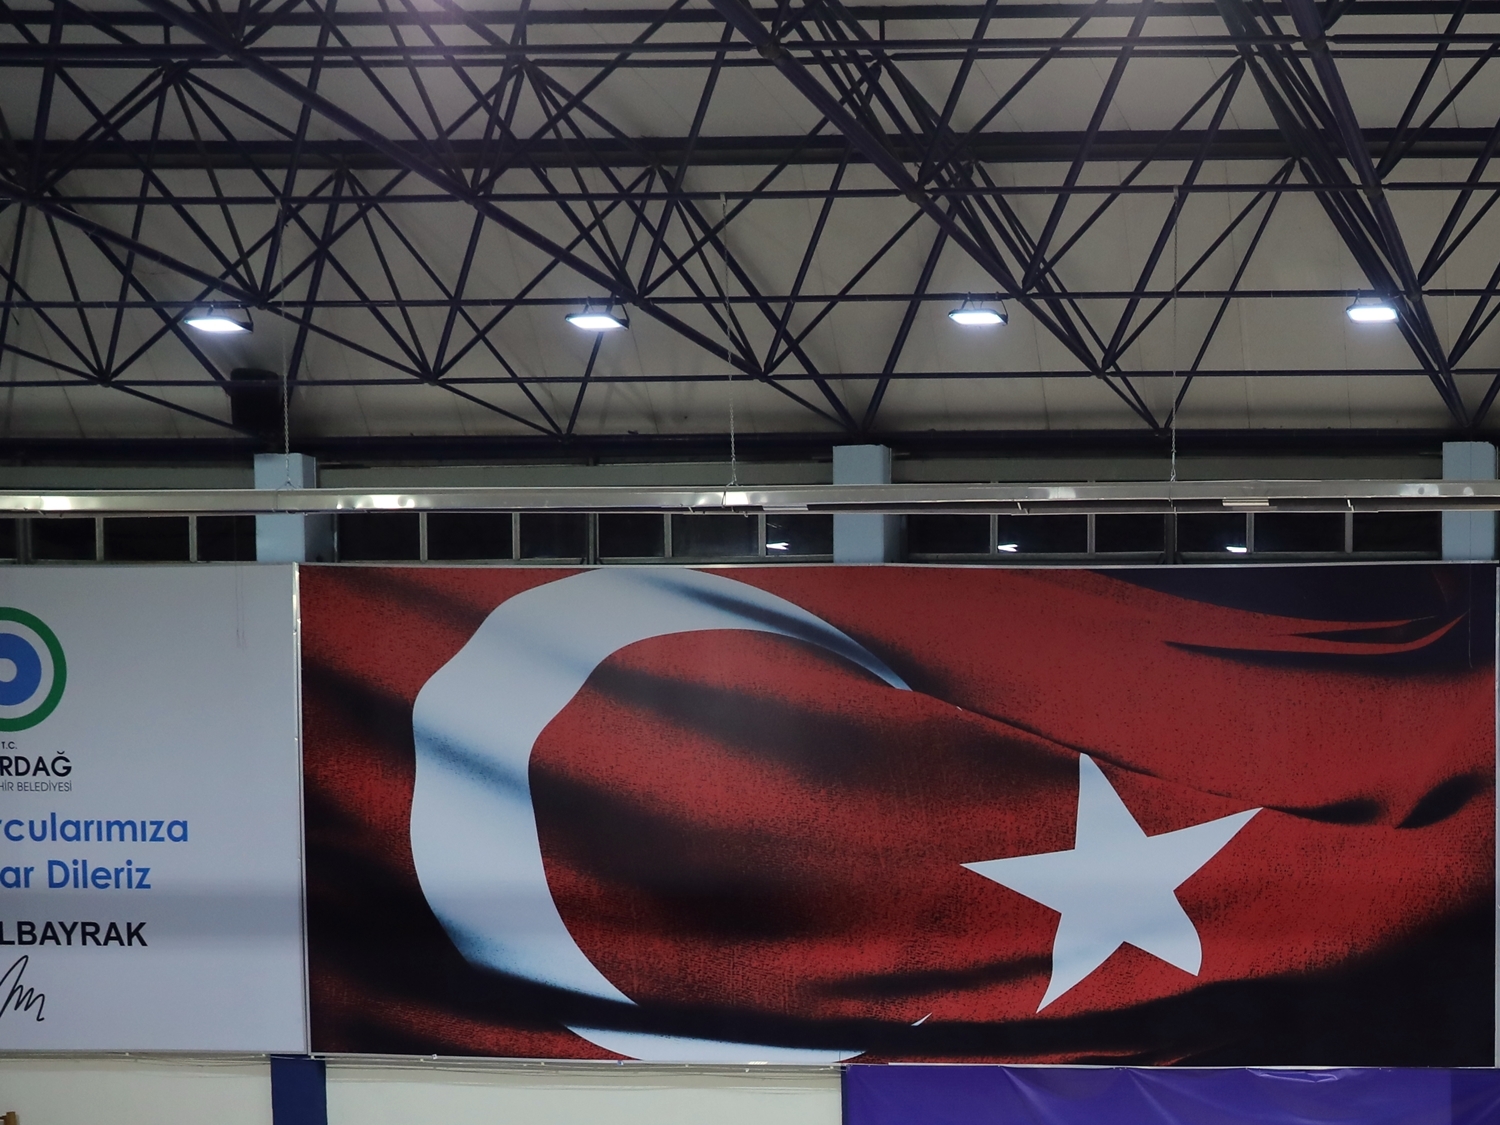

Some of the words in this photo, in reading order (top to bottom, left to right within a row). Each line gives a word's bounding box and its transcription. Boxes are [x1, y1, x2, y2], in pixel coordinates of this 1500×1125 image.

[17, 780, 72, 791] BELEDİYESİ
[0, 812, 188, 842] cularımıza
[48, 859, 151, 889] Dileriz
